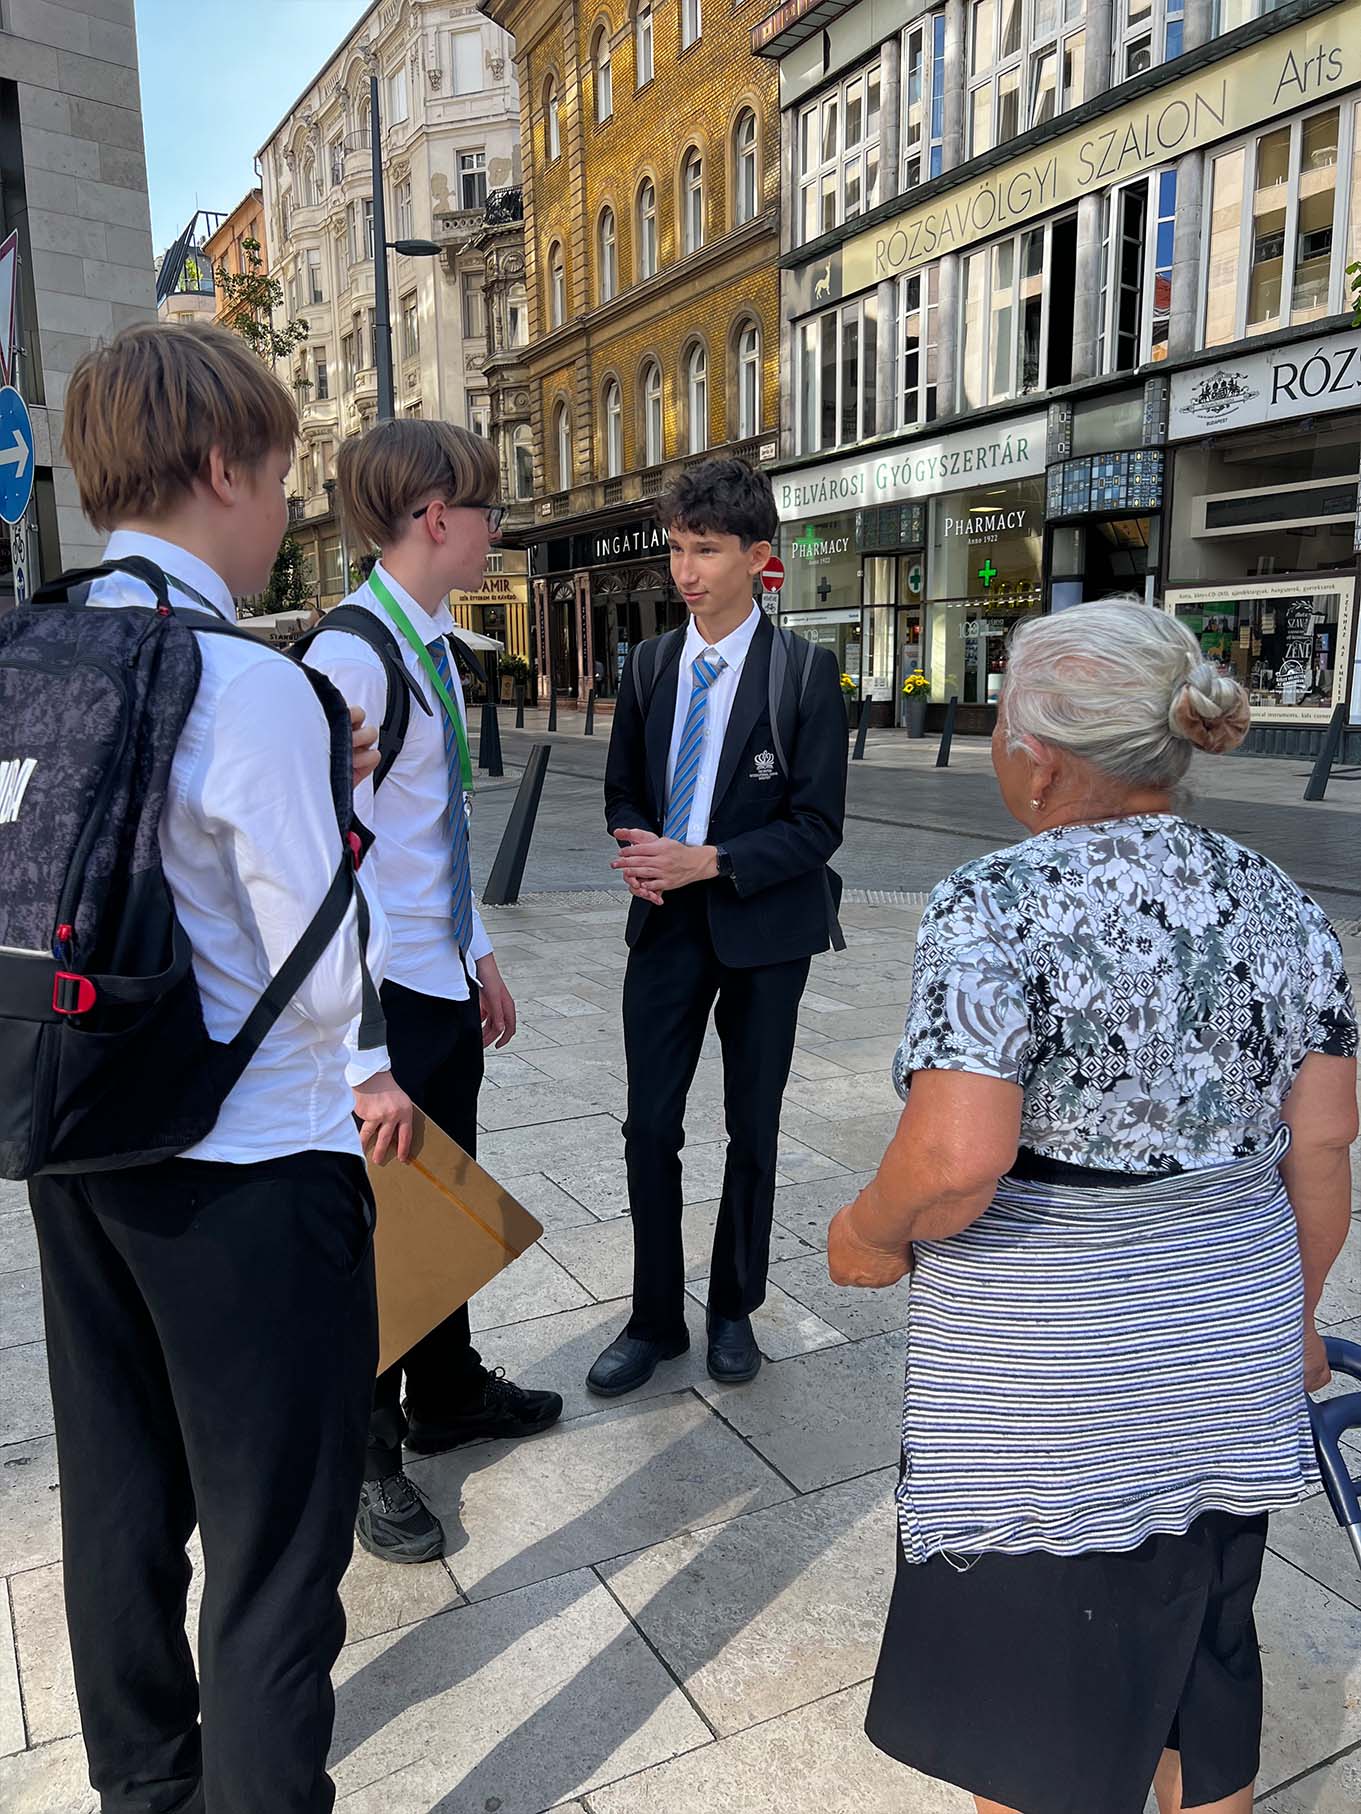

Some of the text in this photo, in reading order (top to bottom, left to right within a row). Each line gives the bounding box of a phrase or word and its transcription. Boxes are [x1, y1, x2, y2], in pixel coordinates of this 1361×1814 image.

[875, 44, 1343, 275] RÓZSAVÖLGYI SZALON Arts
[1270, 346, 1361, 406] RÓZ
[596, 527, 671, 557] INGATLAN
[983, 534, 999, 544] 1922
